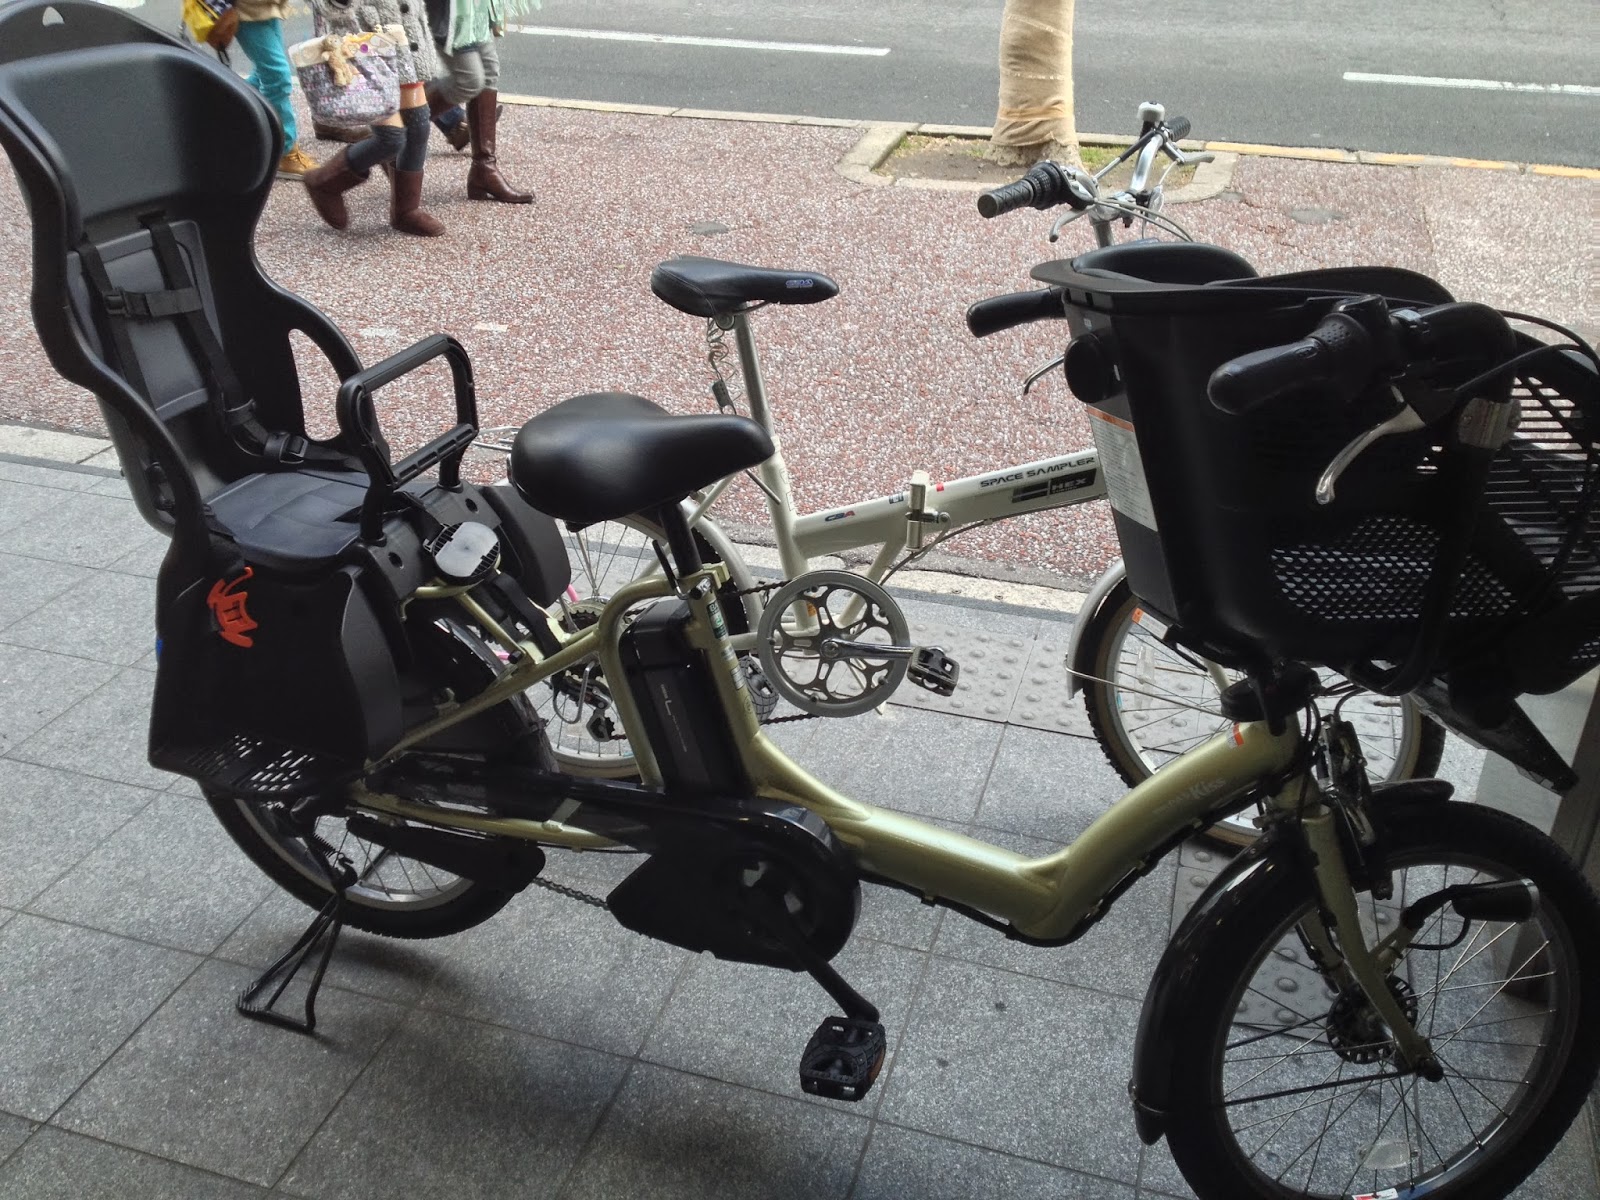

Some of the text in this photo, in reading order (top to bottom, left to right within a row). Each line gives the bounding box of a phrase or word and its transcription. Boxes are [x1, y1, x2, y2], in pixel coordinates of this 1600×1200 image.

[980, 457, 1095, 488] SPACE SAMPLER
[1050, 478, 1087, 491] HEX
